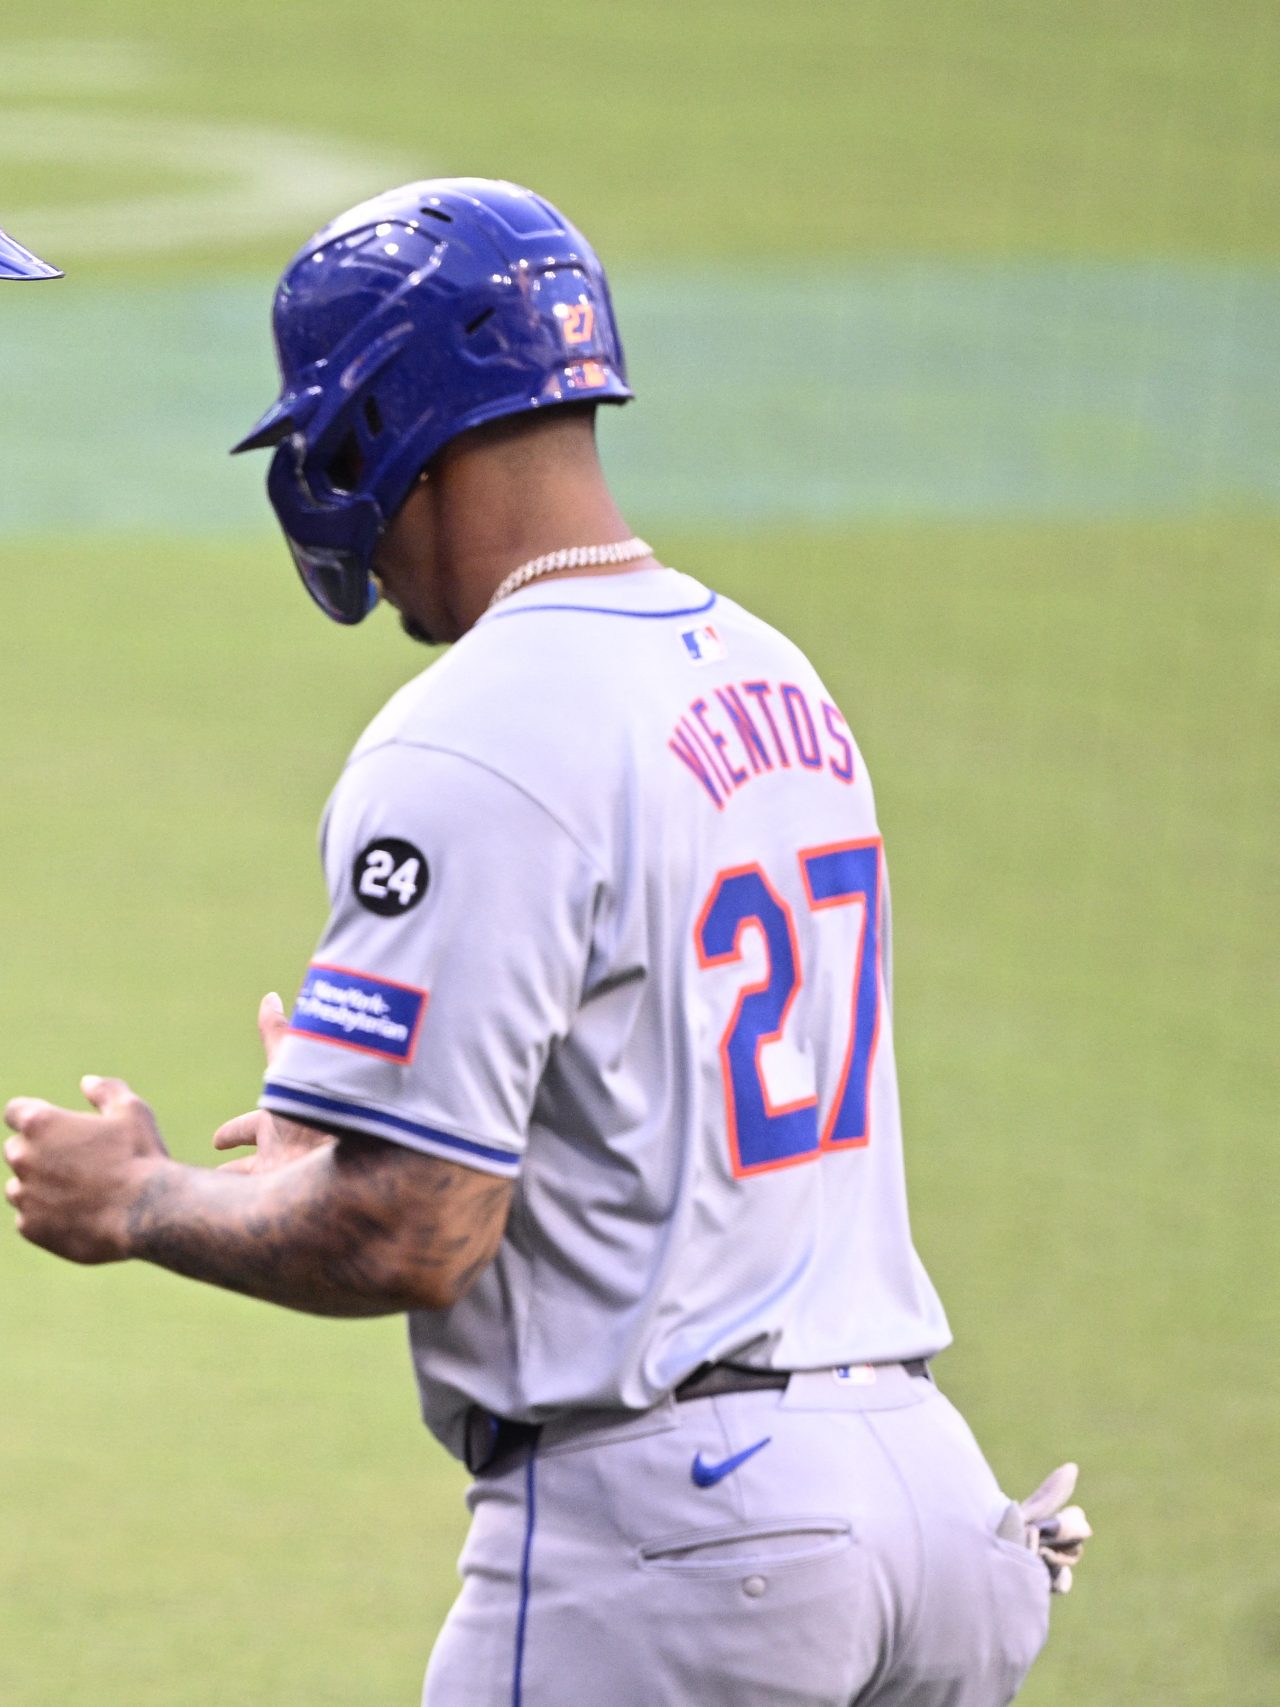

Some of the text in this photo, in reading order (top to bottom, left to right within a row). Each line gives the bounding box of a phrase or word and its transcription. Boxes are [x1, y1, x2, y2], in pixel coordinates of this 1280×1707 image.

[669, 681, 854, 812] VIENTOS
[359, 849, 420, 905] 24
[694, 835, 883, 1179] 27
